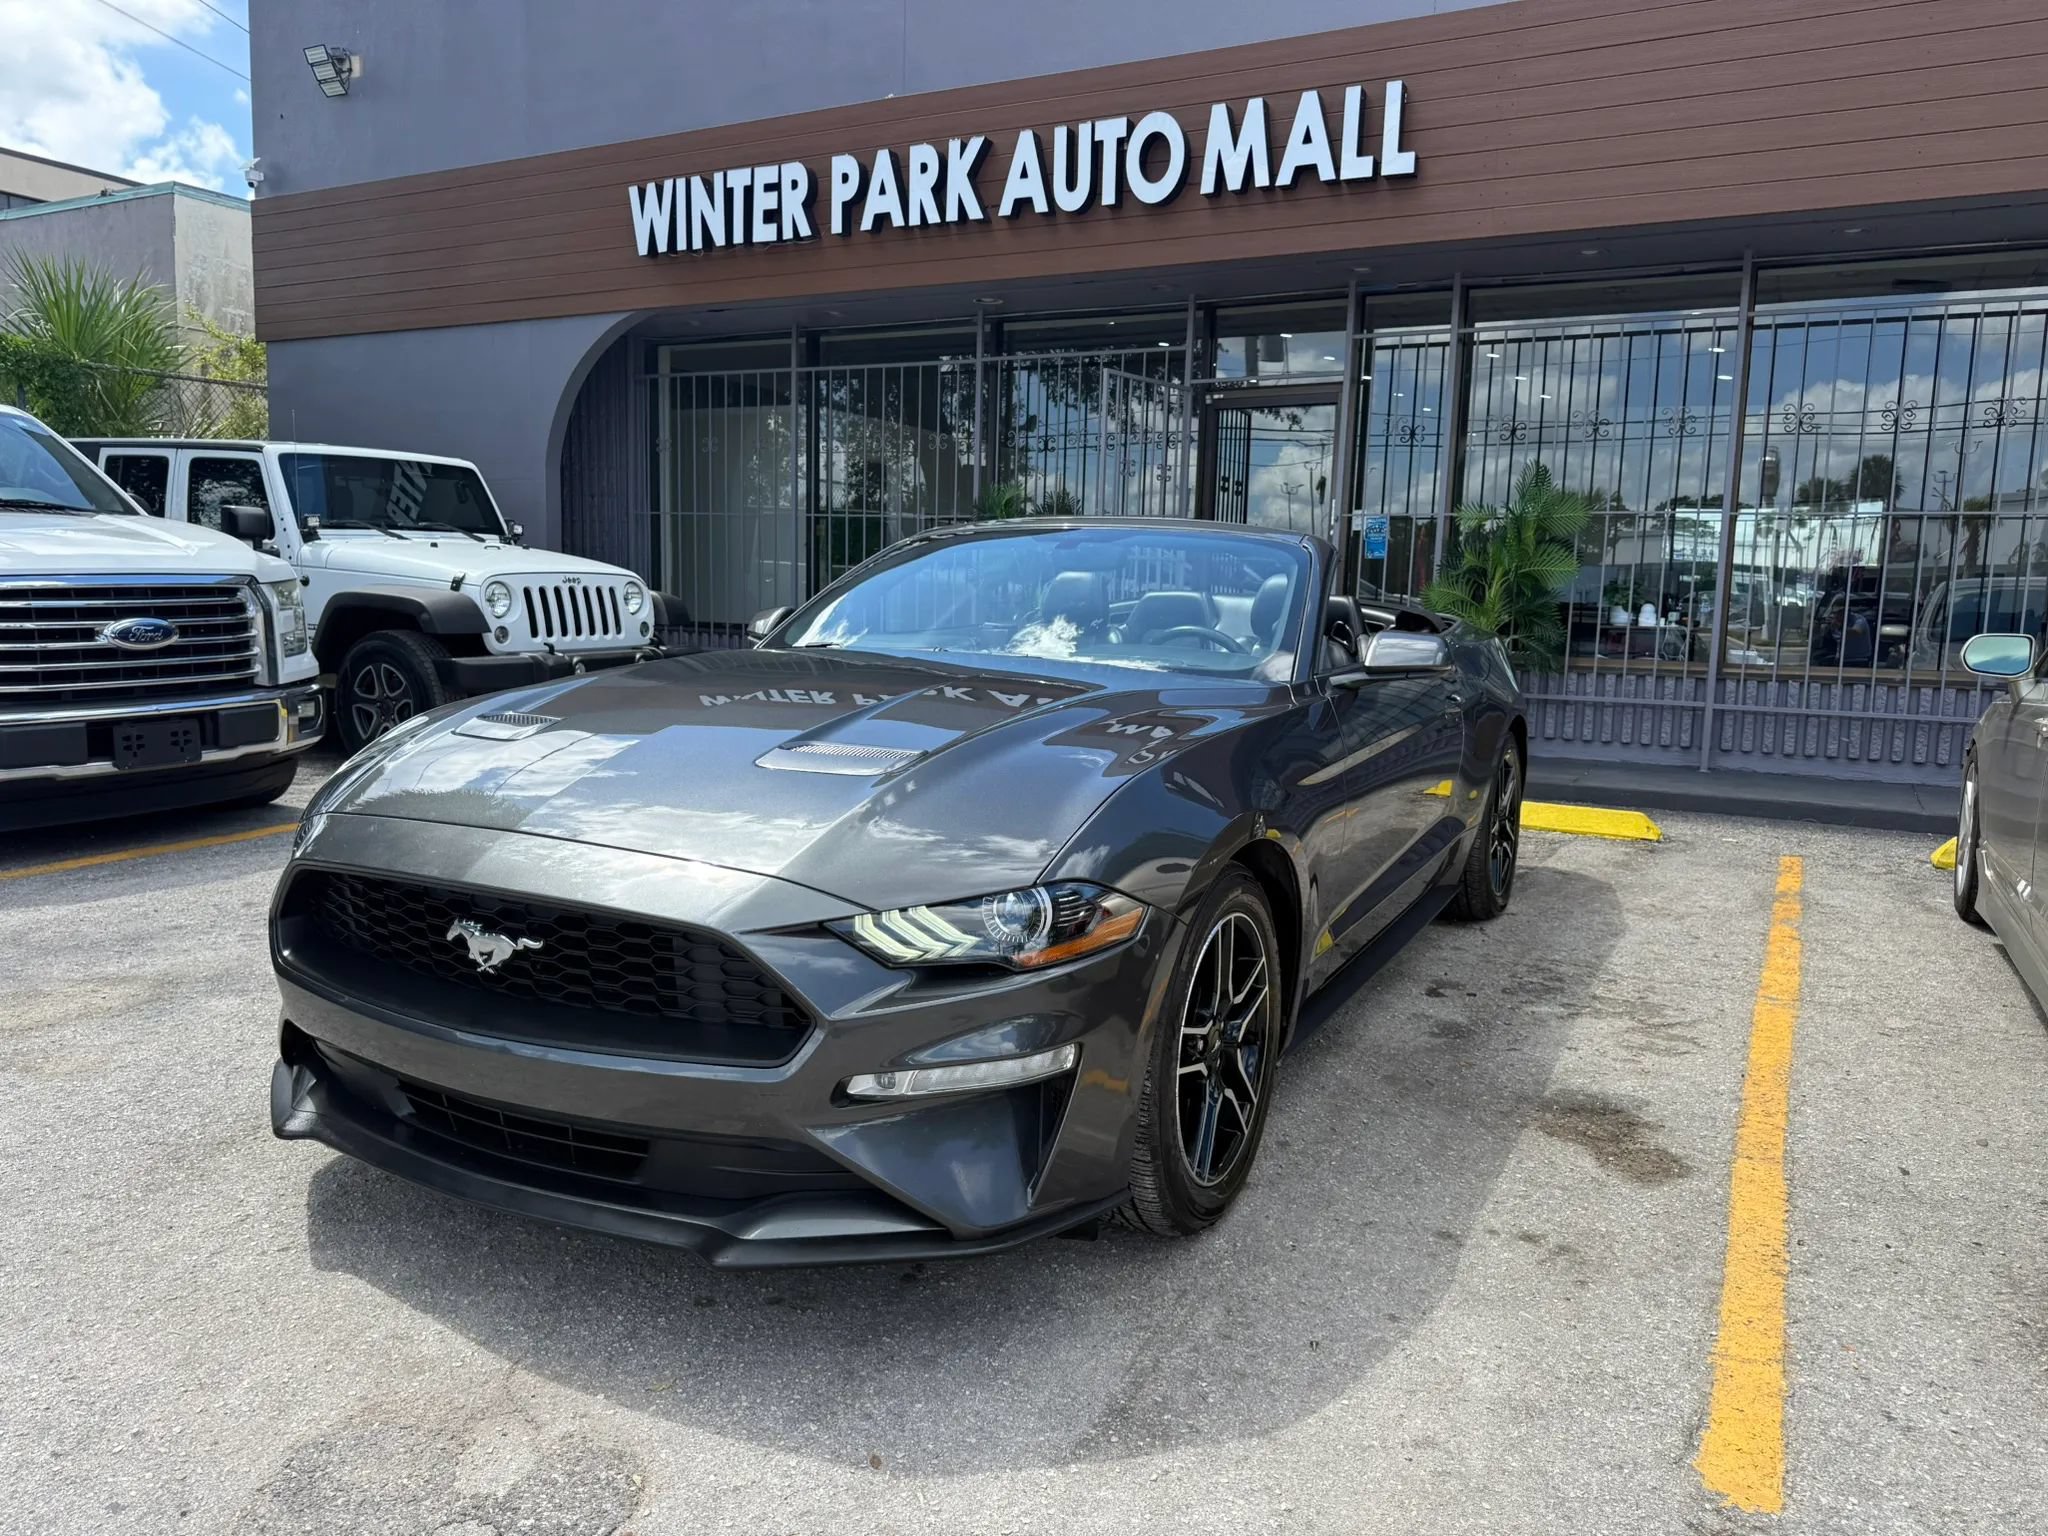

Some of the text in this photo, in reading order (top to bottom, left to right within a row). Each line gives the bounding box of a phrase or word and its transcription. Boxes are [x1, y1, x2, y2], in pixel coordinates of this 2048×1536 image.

[628, 79, 1417, 256] WINTER PARK AUTO MALL
[562, 575, 581, 585] Jeep
[128, 626, 164, 641] Ford
